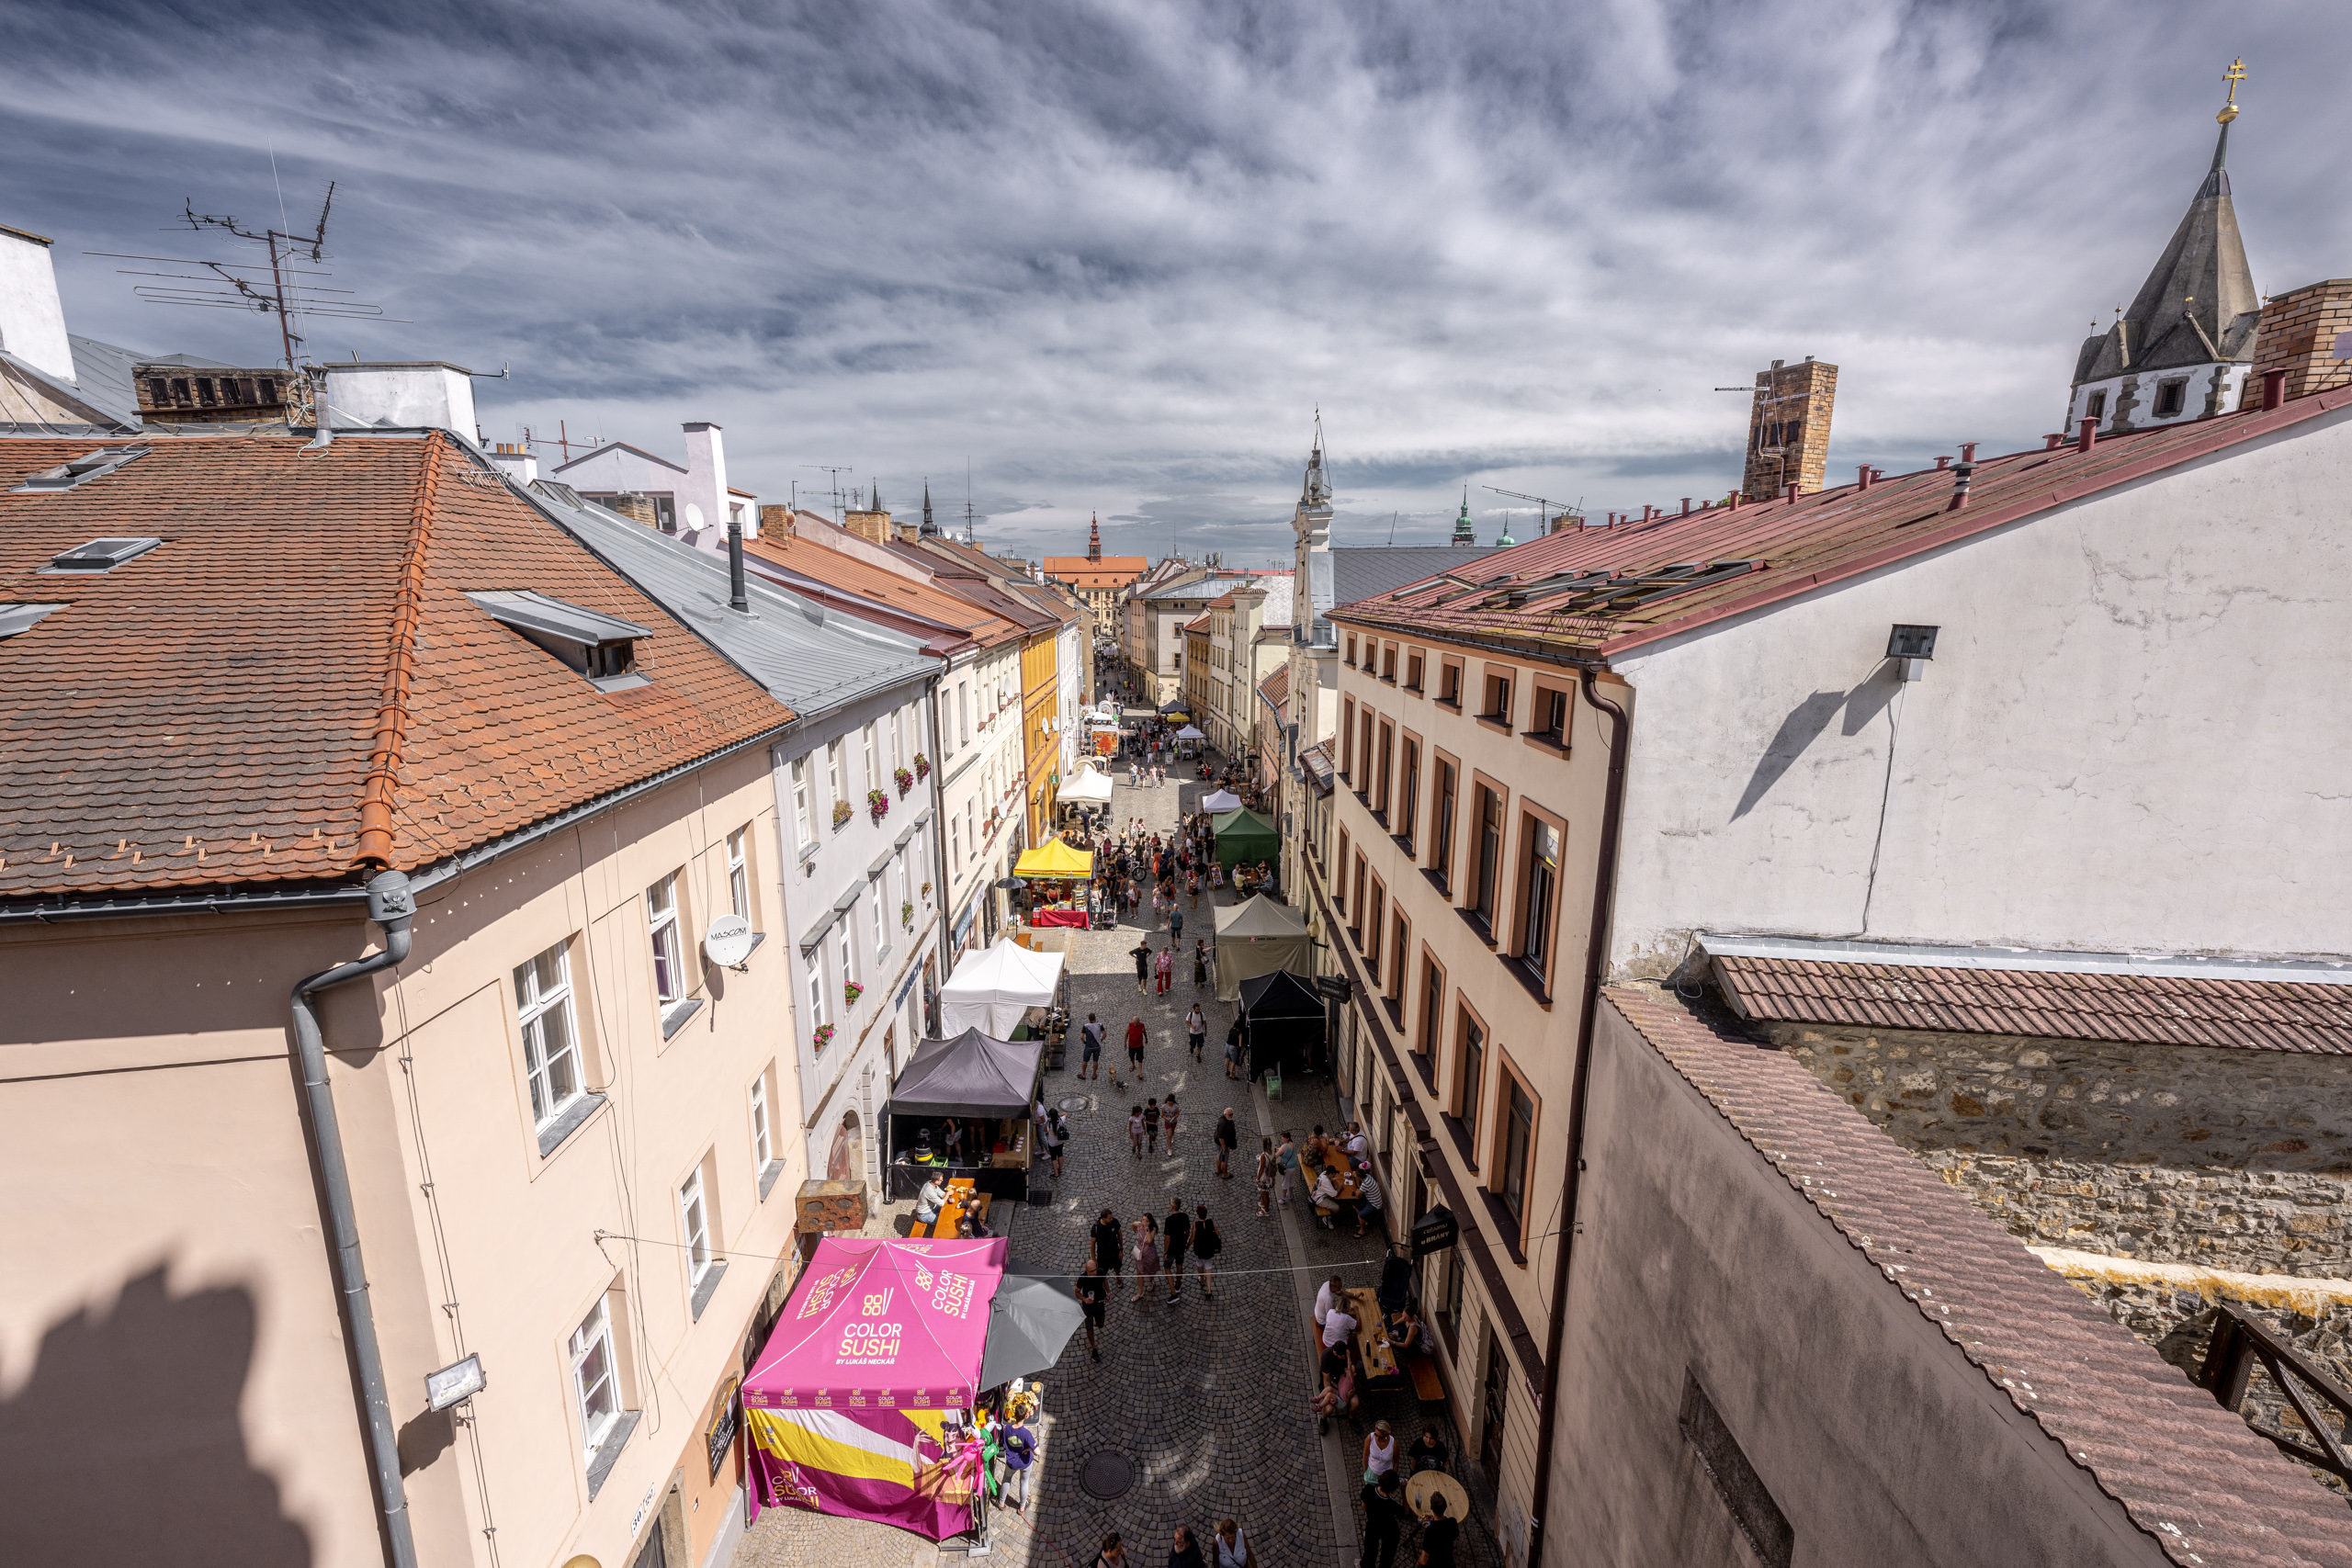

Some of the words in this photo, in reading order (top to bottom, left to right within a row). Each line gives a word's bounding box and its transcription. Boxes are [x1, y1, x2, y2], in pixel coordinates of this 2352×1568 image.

[710, 927, 747, 941] MASCOM
[1426, 1231, 1450, 1244] BRÁNY
[804, 1273, 834, 1317] SUSHI
[819, 1269, 844, 1312] COLOR
[932, 1269, 953, 1310] COLOR
[944, 1273, 968, 1316] SUSHI
[844, 1323, 902, 1337] COLOR
[838, 1338, 900, 1356] SUSHI
[845, 1357, 867, 1365] LUKÁŠ
[867, 1357, 895, 1365] NECKÁŘ
[632, 1511, 641, 1530] 30
